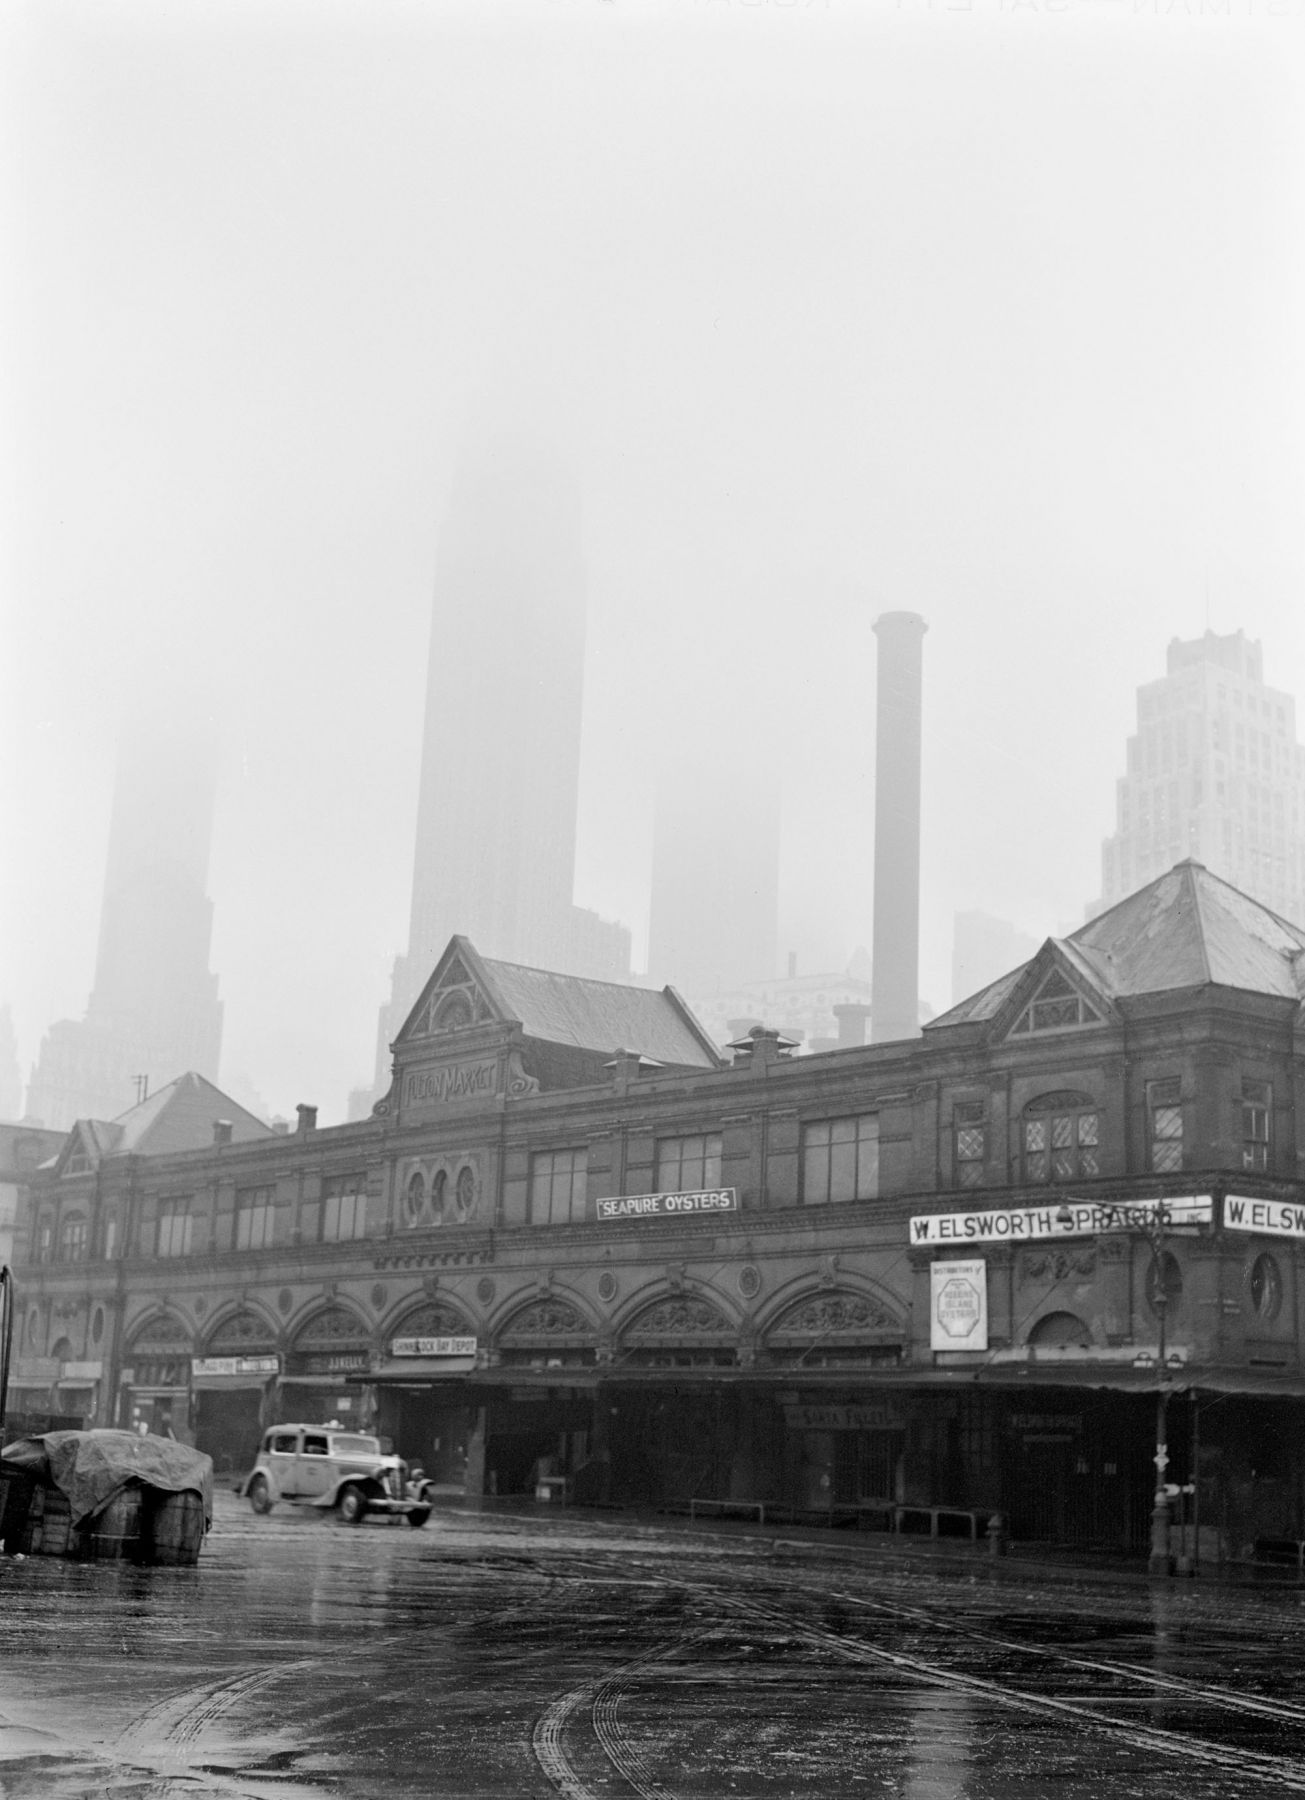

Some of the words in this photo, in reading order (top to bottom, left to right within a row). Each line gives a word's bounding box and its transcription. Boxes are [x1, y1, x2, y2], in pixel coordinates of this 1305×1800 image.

[404, 1073, 444, 1107] FULTON
[443, 1064, 496, 1102] MARKET
[665, 1191, 730, 1211] OYSTERS
